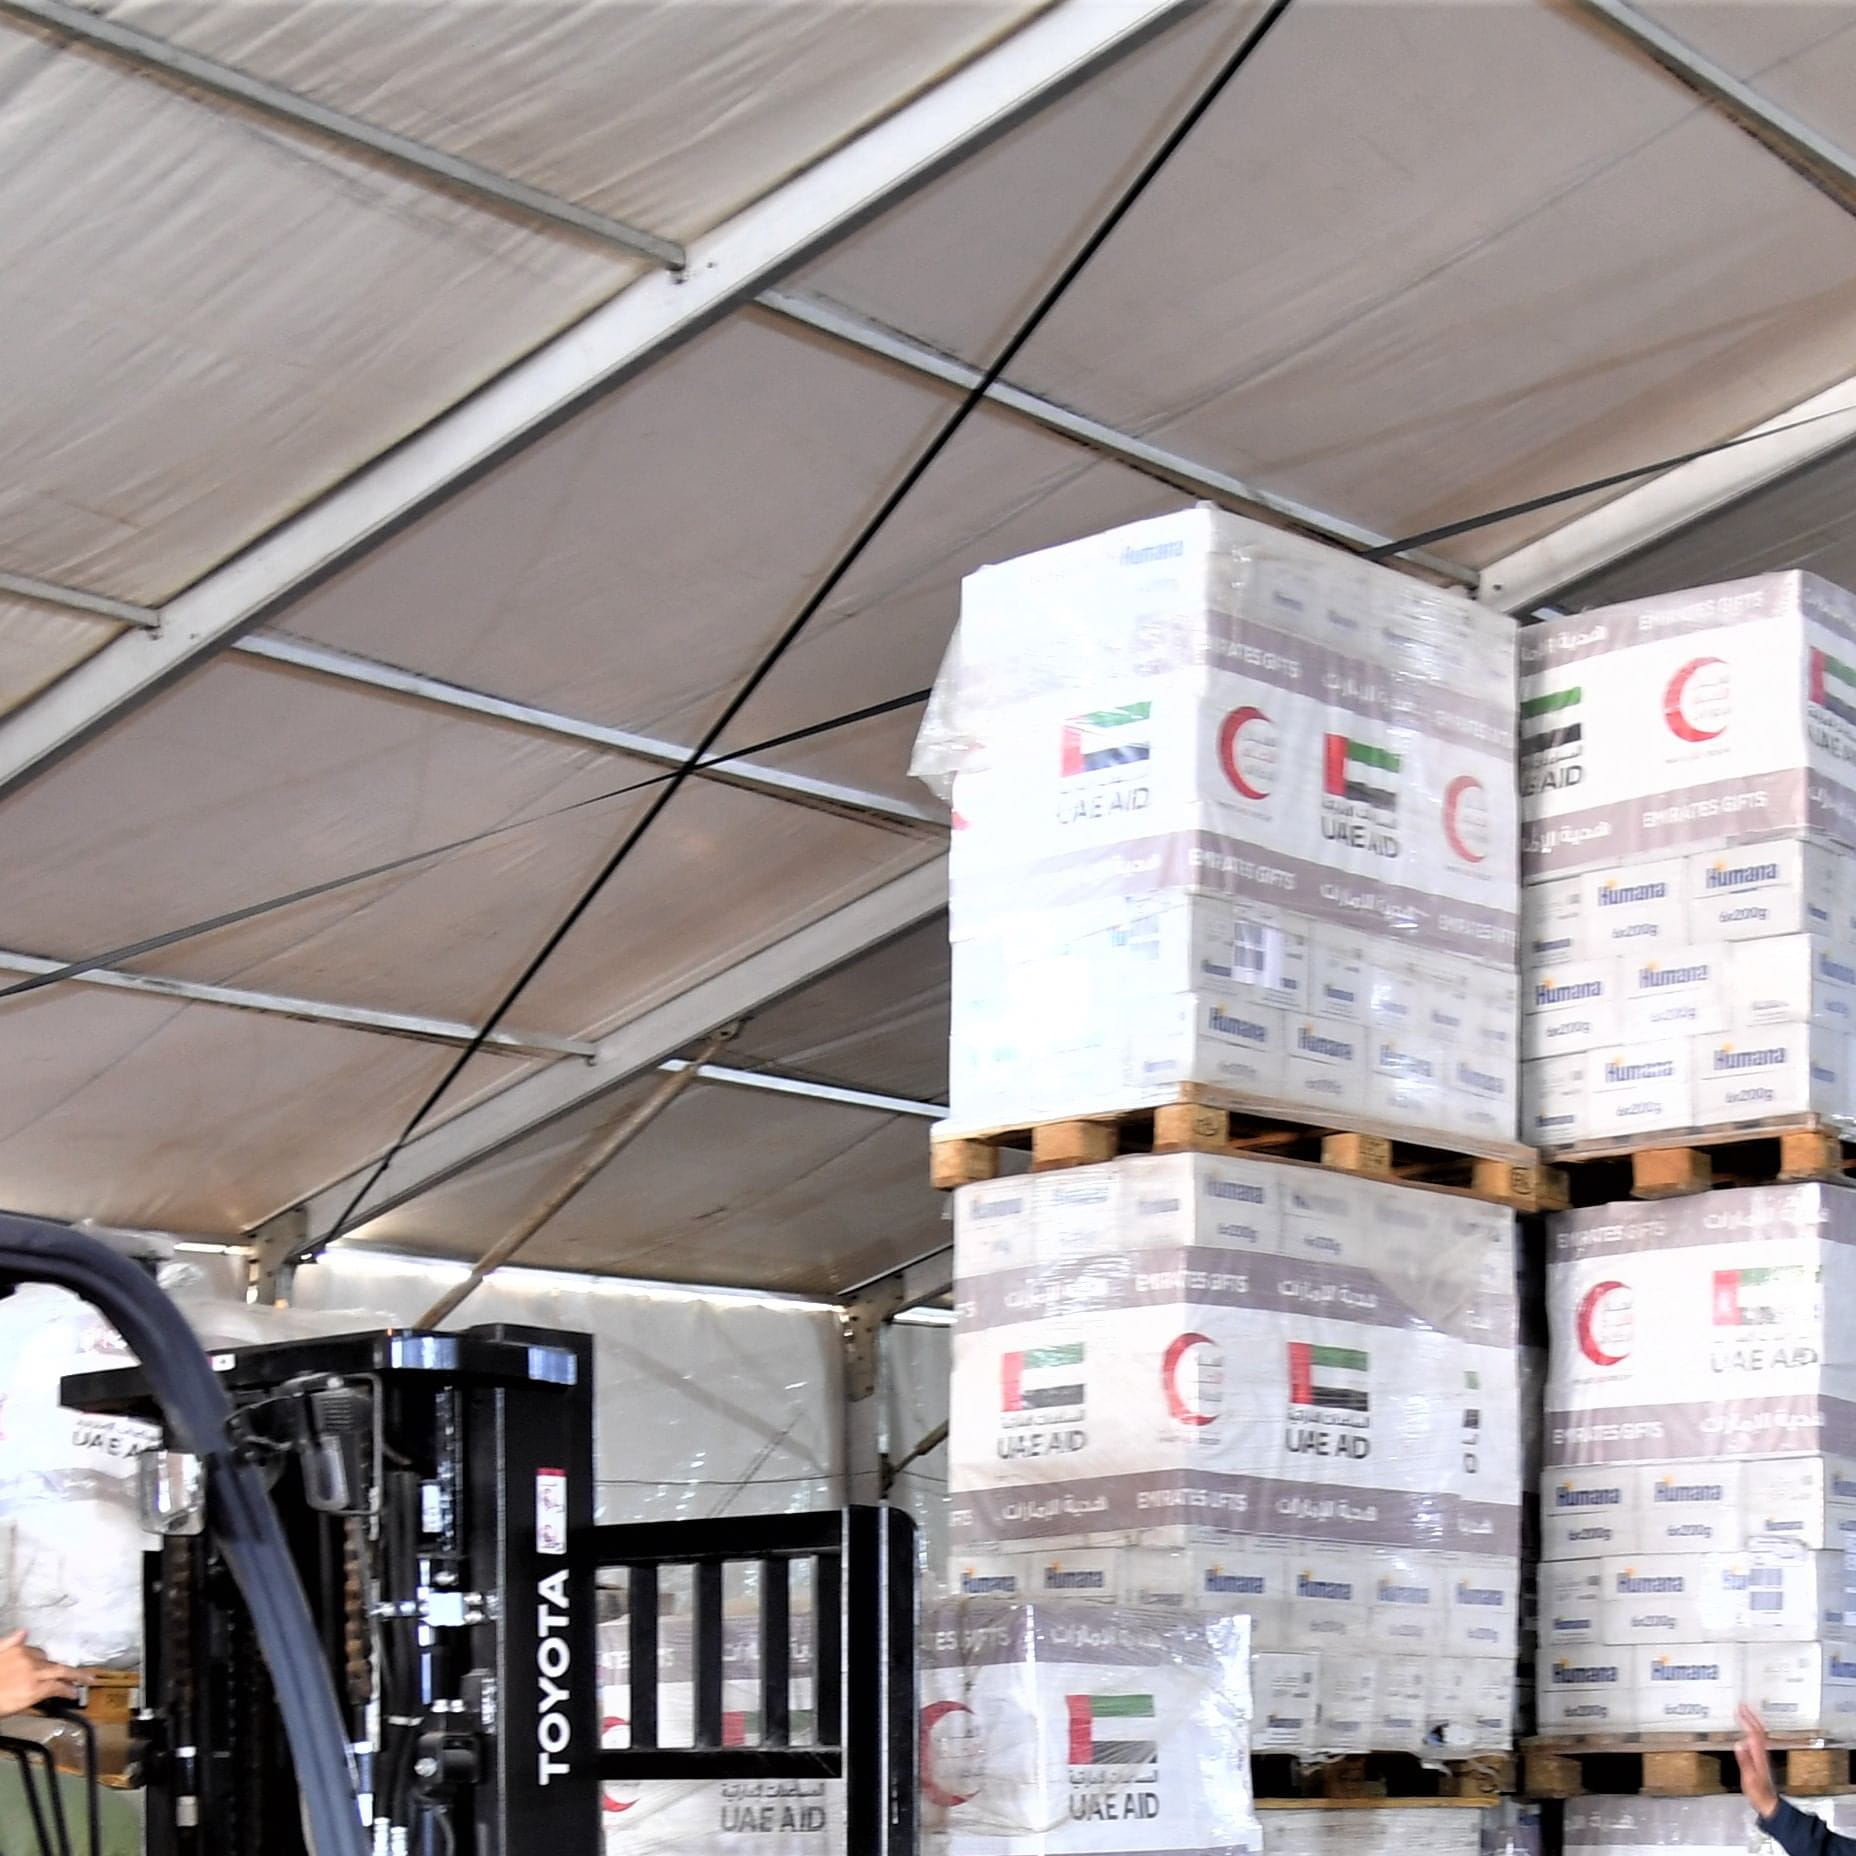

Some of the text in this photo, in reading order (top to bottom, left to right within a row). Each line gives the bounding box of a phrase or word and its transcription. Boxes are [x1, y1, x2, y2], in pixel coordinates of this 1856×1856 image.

[1706, 864, 1777, 889] Humana
[1598, 882, 1666, 906] Humana
[1536, 982, 1601, 1005] Humana
[1714, 1048, 1786, 1070] Humana
[998, 1430, 1088, 1459] UAE AID
[1286, 1428, 1371, 1459] UAE AID
[537, 1568, 571, 1786] TOYOTA
[721, 1806, 826, 1833] UAE AID
[1069, 1792, 1160, 1821] UAE AID
